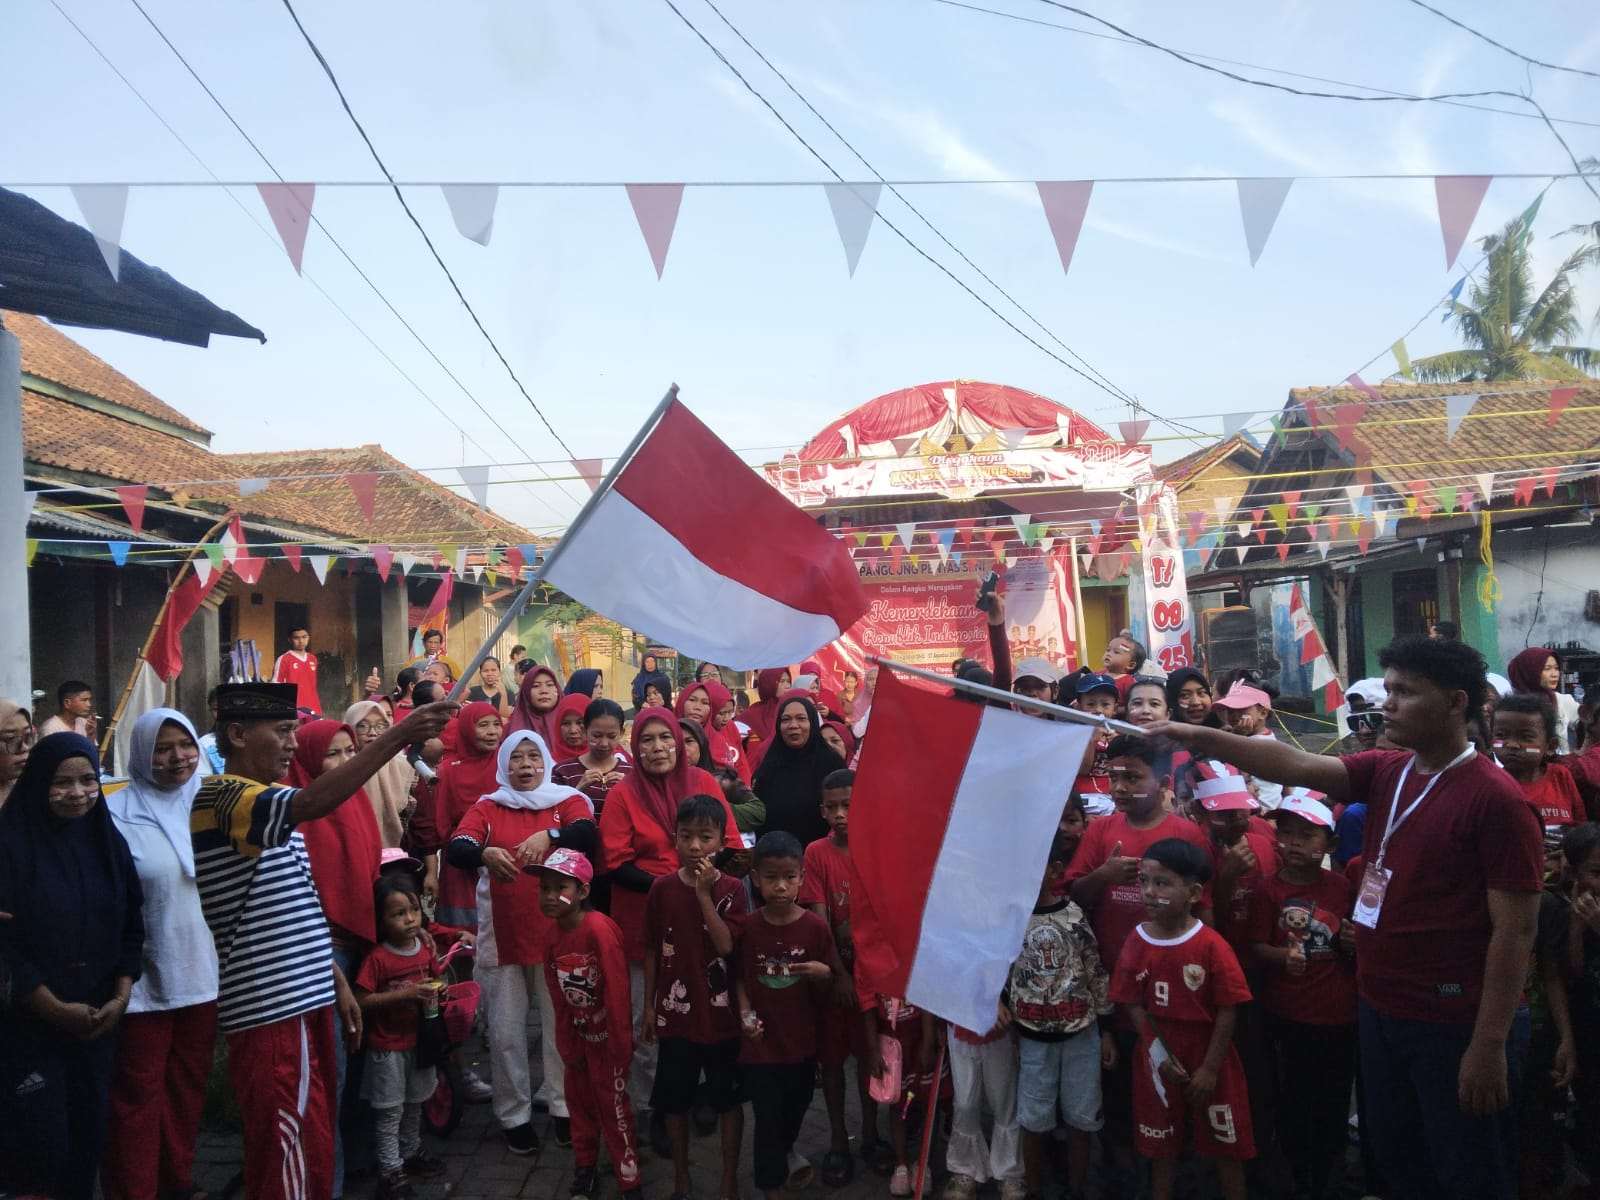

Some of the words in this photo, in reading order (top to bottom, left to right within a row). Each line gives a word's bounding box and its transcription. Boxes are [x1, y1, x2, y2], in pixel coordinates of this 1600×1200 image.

[870, 596, 978, 622] Kemerdekaan
[1152, 600, 1183, 630] 08
[863, 622, 921, 654] Republik
[923, 621, 988, 645] Indonesia
[1158, 645, 1188, 673] 25
[1154, 981, 1169, 1006] 9
[1138, 1124, 1174, 1138] sport
[1208, 1103, 1238, 1144] 9
